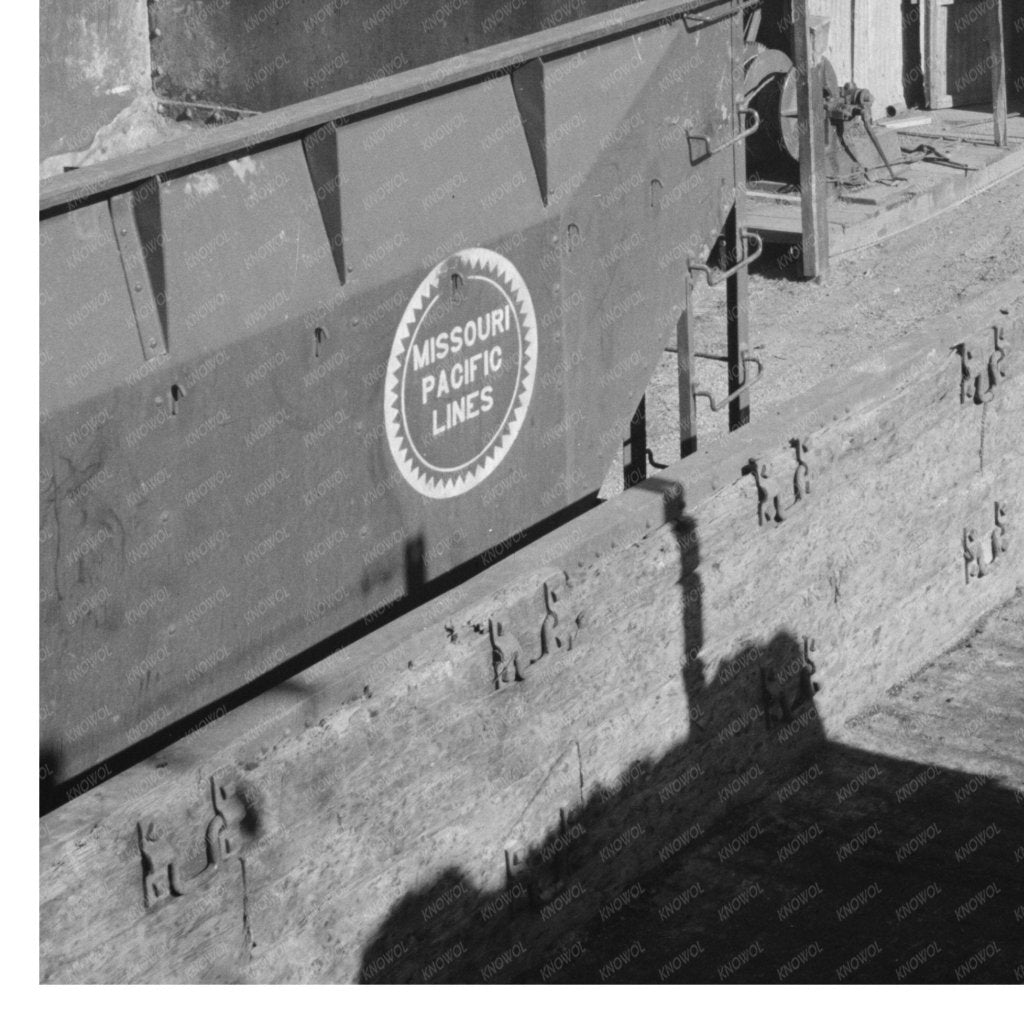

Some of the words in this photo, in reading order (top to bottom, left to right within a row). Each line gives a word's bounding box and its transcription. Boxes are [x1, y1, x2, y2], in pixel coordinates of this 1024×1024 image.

[413, 304, 510, 372] MISSOURI
[422, 345, 502, 405] PACIFIC
[432, 385, 494, 436] LINES
